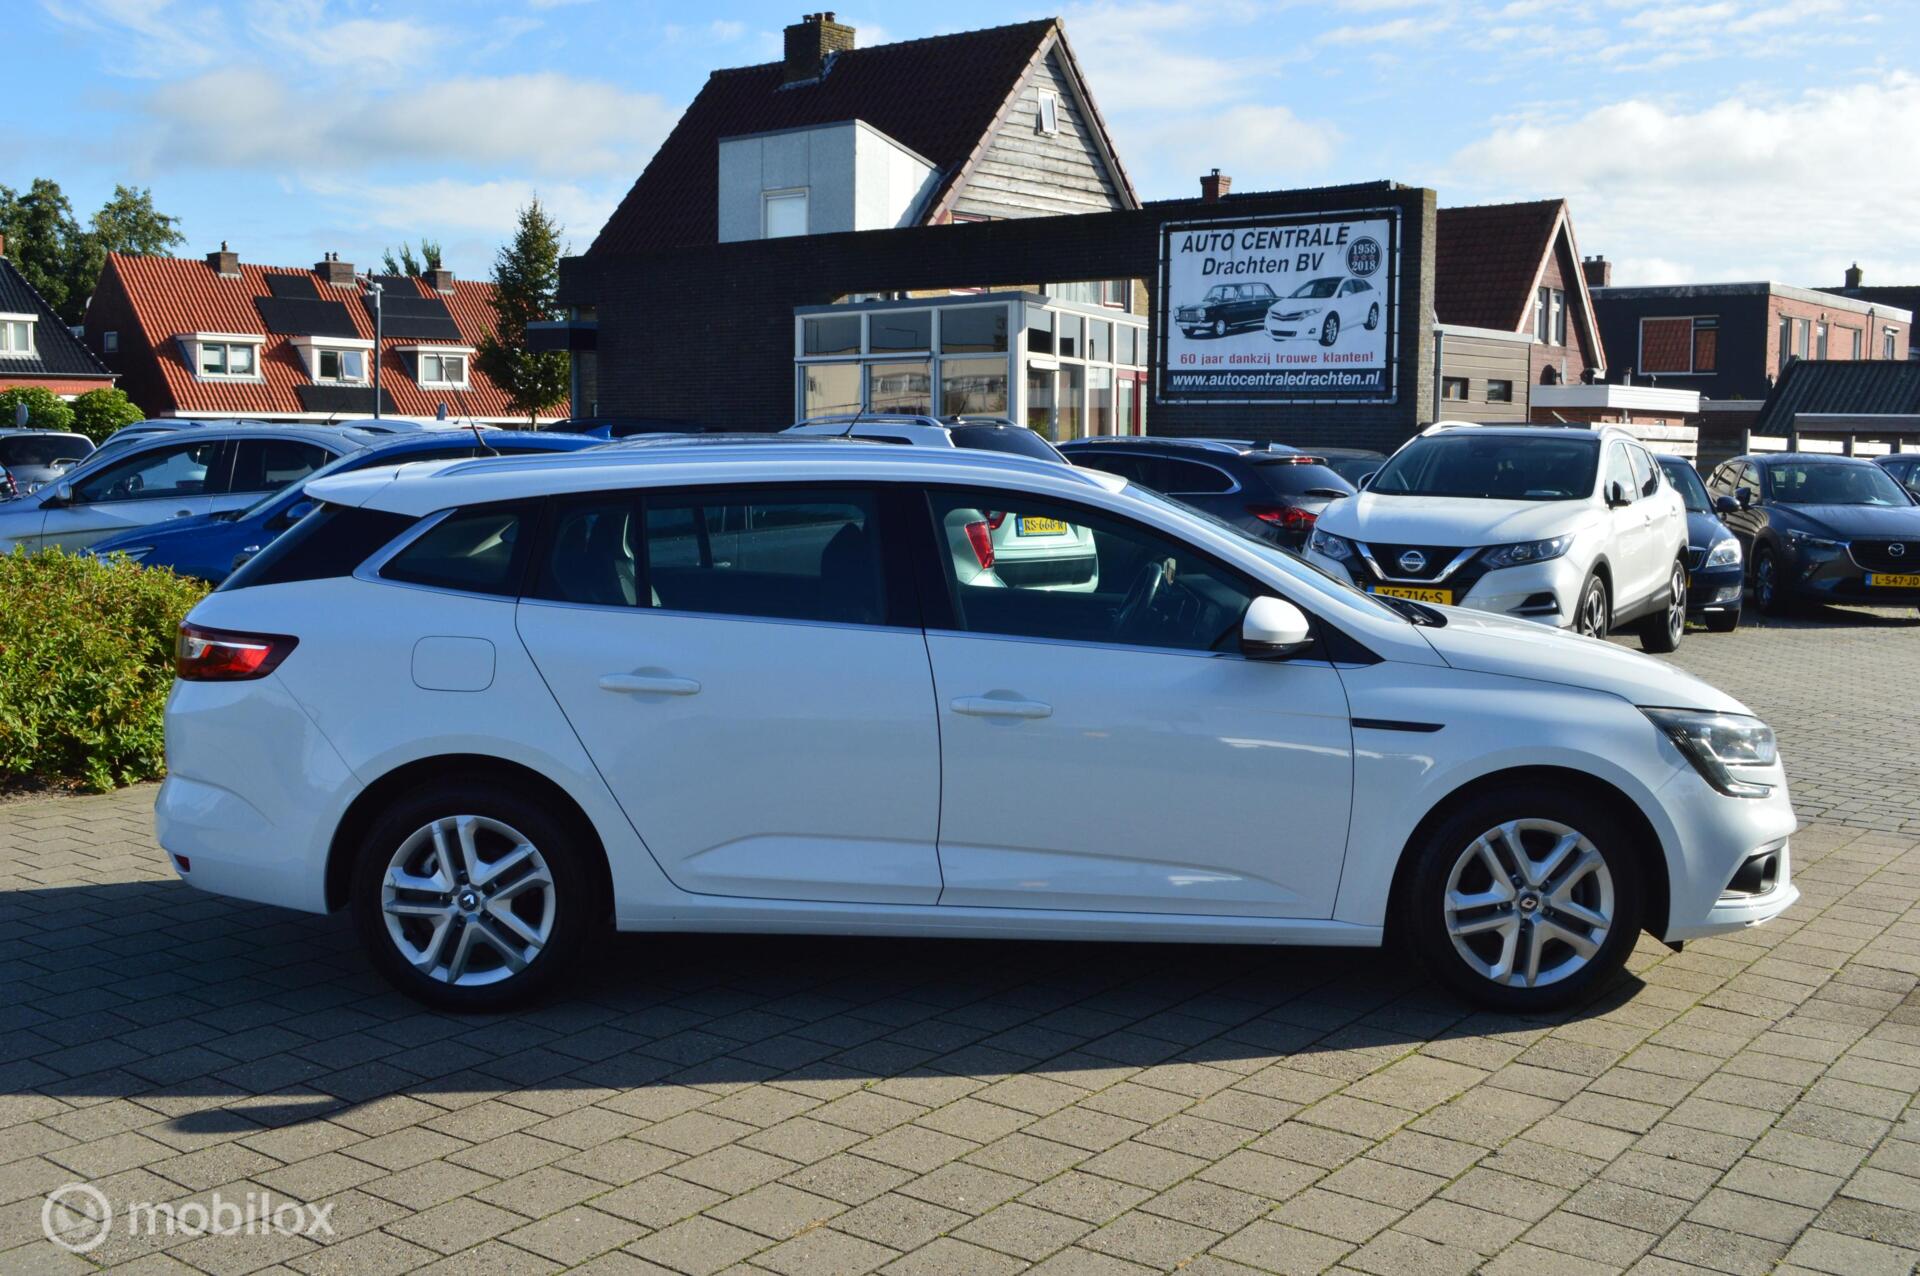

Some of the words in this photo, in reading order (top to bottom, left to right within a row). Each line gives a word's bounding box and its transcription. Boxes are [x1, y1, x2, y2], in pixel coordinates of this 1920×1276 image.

[1181, 232, 1235, 253] AUTO
[1241, 226, 1350, 250] CENTRALE
[1352, 243, 1377, 255] 1958
[1202, 255, 1289, 275] Drachten
[1295, 252, 1325, 272] BV
[1351, 260, 1377, 271] 2018
[1180, 353, 1196, 364] 60
[1201, 353, 1224, 365] jaar
[1229, 352, 1271, 365] dankzij
[1276, 353, 1317, 363] trouwe
[1323, 351, 1374, 363] klanten!
[1172, 371, 1380, 386] www.autocentraledrachten.nl
